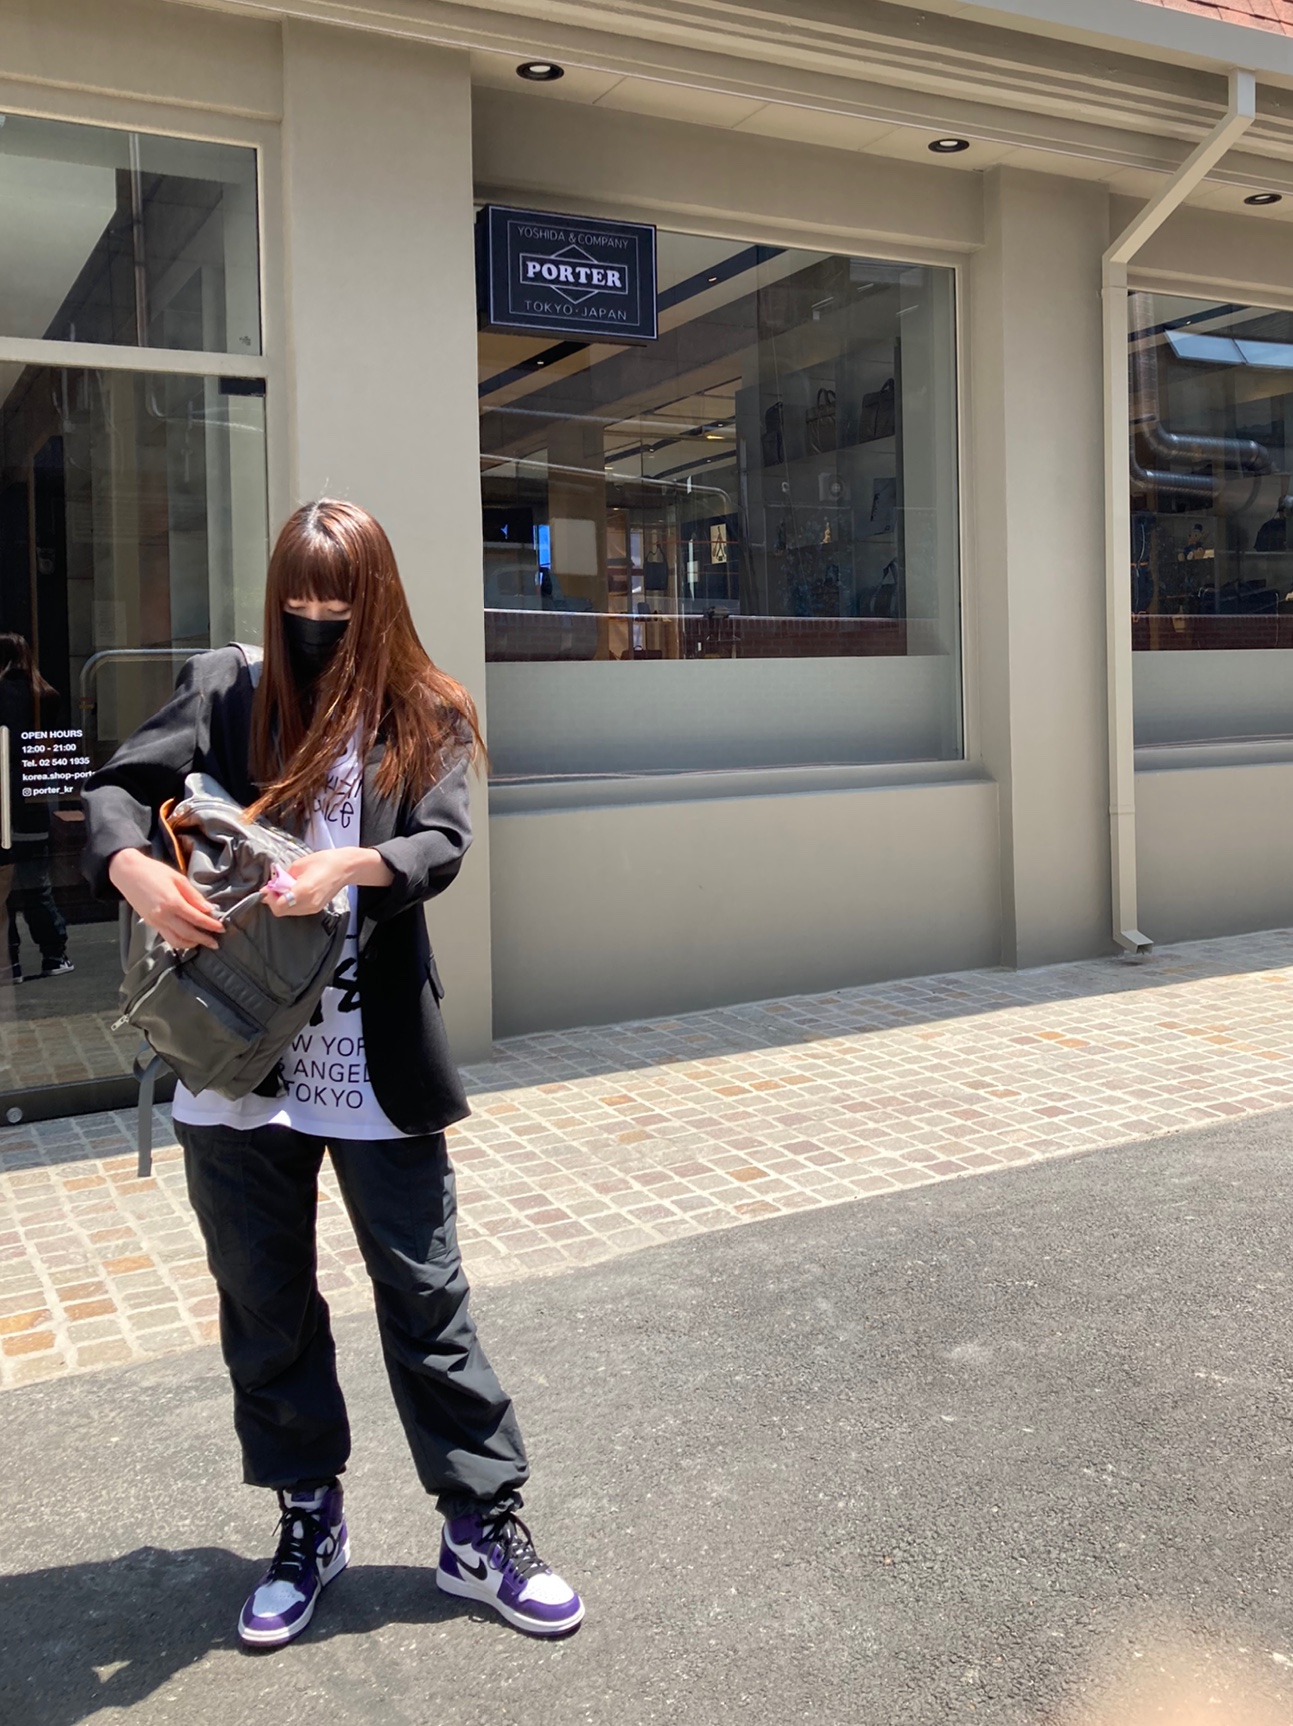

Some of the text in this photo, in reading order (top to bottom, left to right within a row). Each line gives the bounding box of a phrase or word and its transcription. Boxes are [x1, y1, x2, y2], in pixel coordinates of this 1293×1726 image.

[517, 226, 629, 249] YOSHIDA & COMPANY
[526, 261, 622, 288] PORTER
[21, 729, 83, 740] OPEN HOURS
[21, 745, 46, 754] 12:00
[53, 743, 77, 752] 21:00
[21, 756, 90, 768] Tel. 02 540 1935
[33, 785, 74, 796] porter_kr
